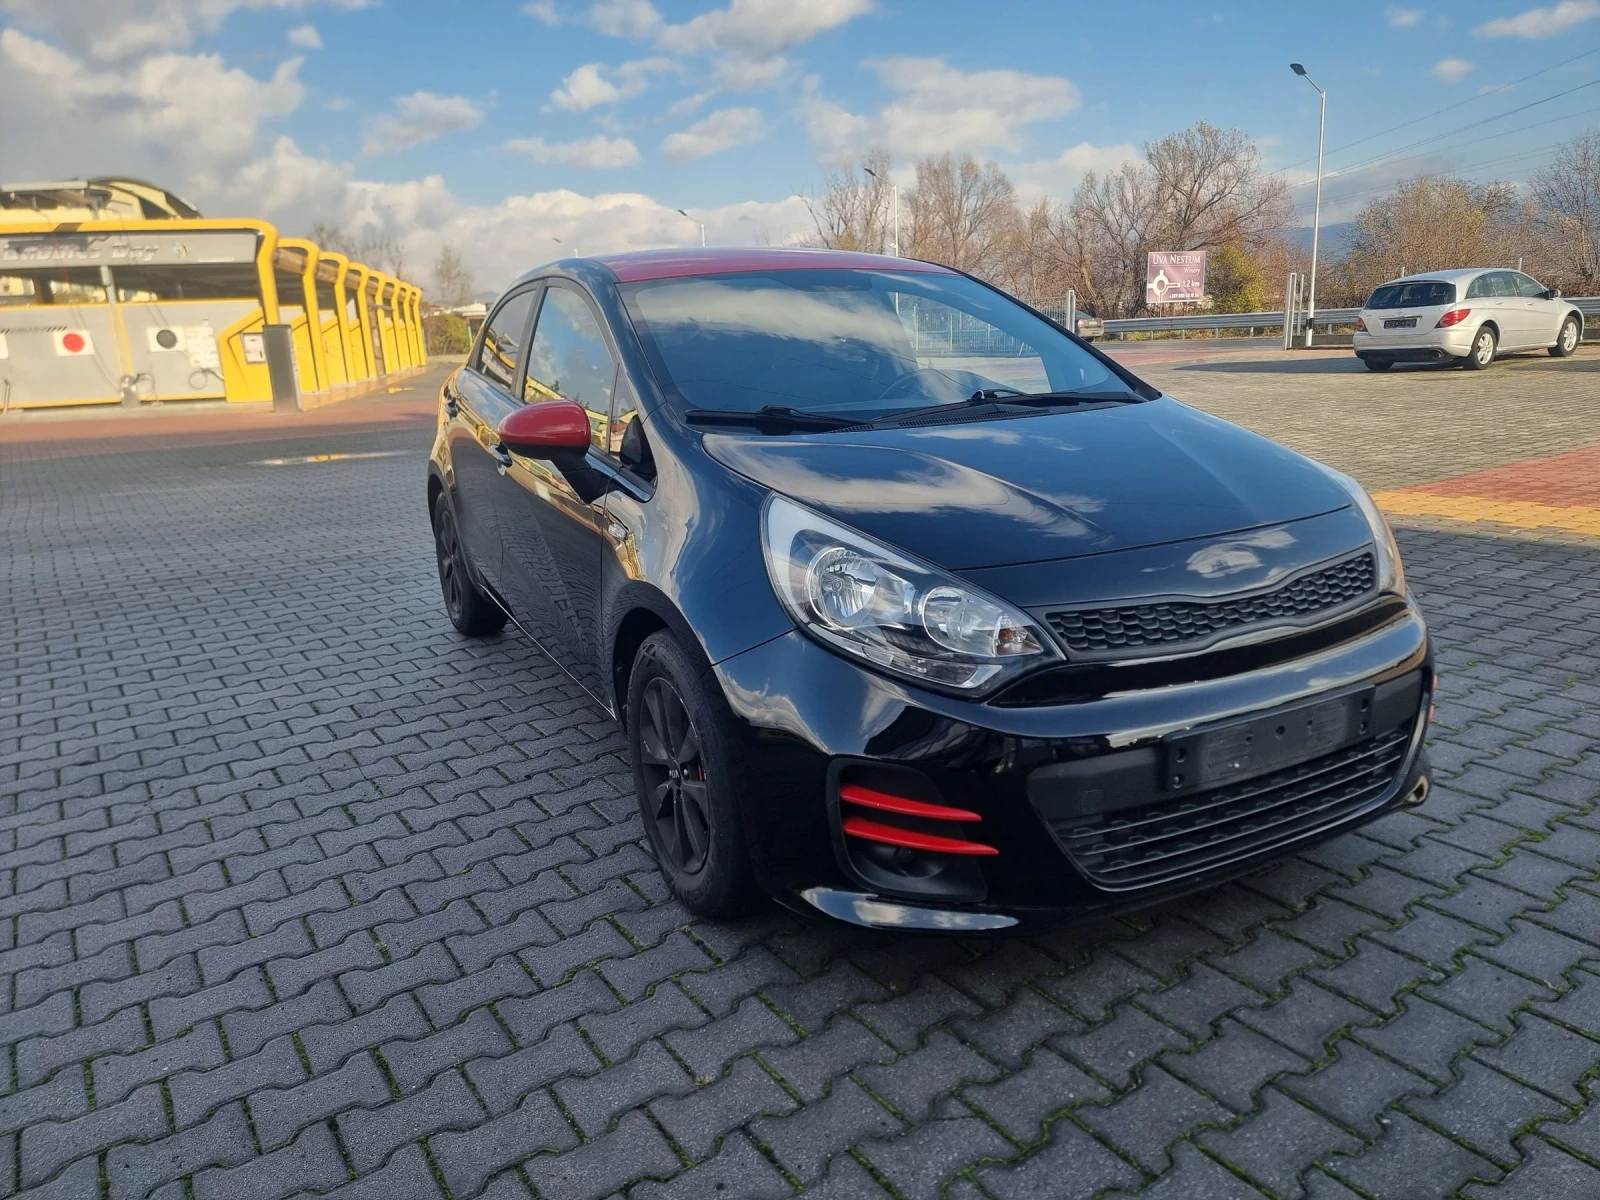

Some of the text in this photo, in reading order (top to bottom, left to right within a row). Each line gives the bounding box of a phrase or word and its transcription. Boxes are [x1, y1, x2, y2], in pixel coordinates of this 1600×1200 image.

[1153, 254, 1201, 264] UVA NESTUM
[1183, 267, 1201, 275] Winery
